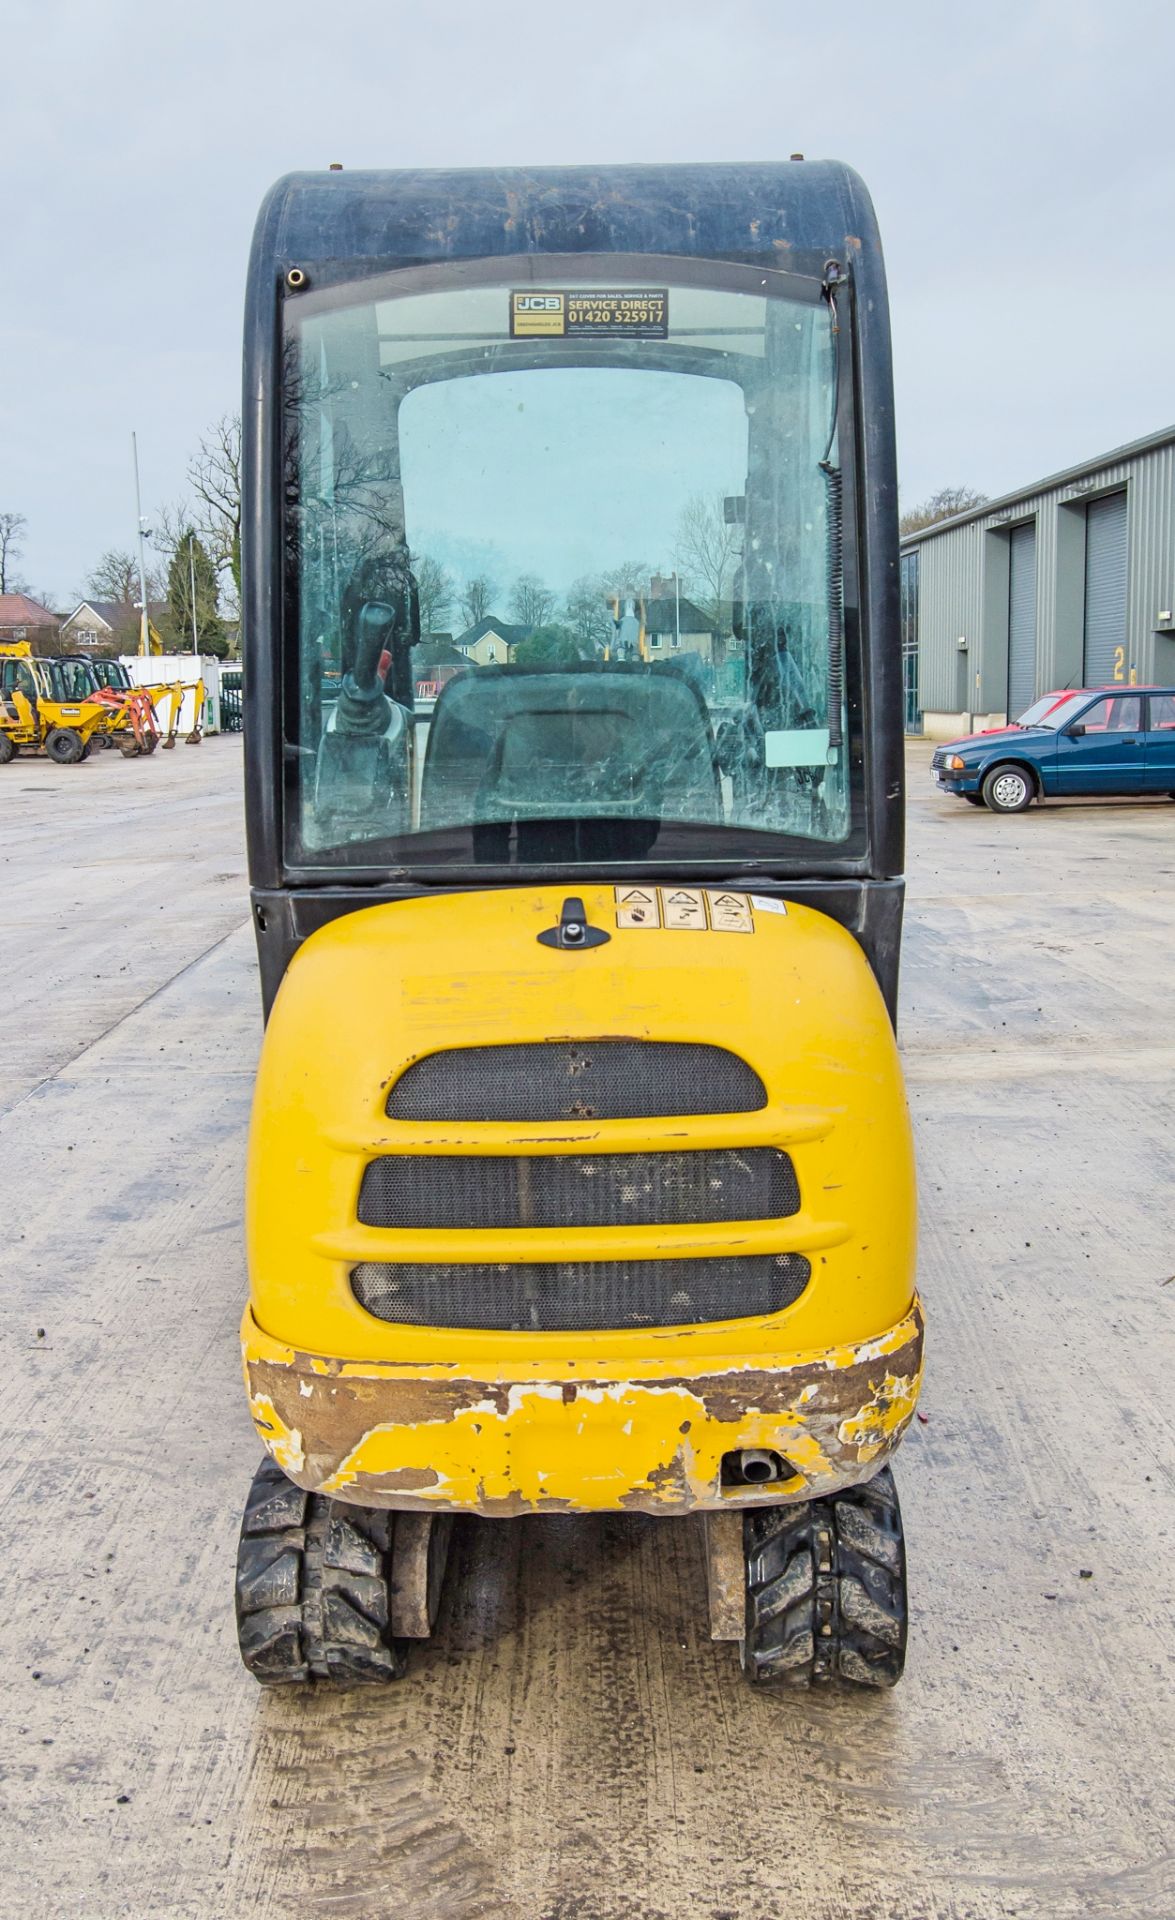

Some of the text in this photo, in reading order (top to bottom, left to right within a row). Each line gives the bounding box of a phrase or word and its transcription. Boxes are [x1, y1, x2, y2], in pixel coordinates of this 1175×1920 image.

[517, 297, 560, 310] JCB
[568, 300, 664, 310] SERVICE DIRECT
[568, 310, 664, 323] 01420 525917
[1114, 646, 1124, 681] 2
